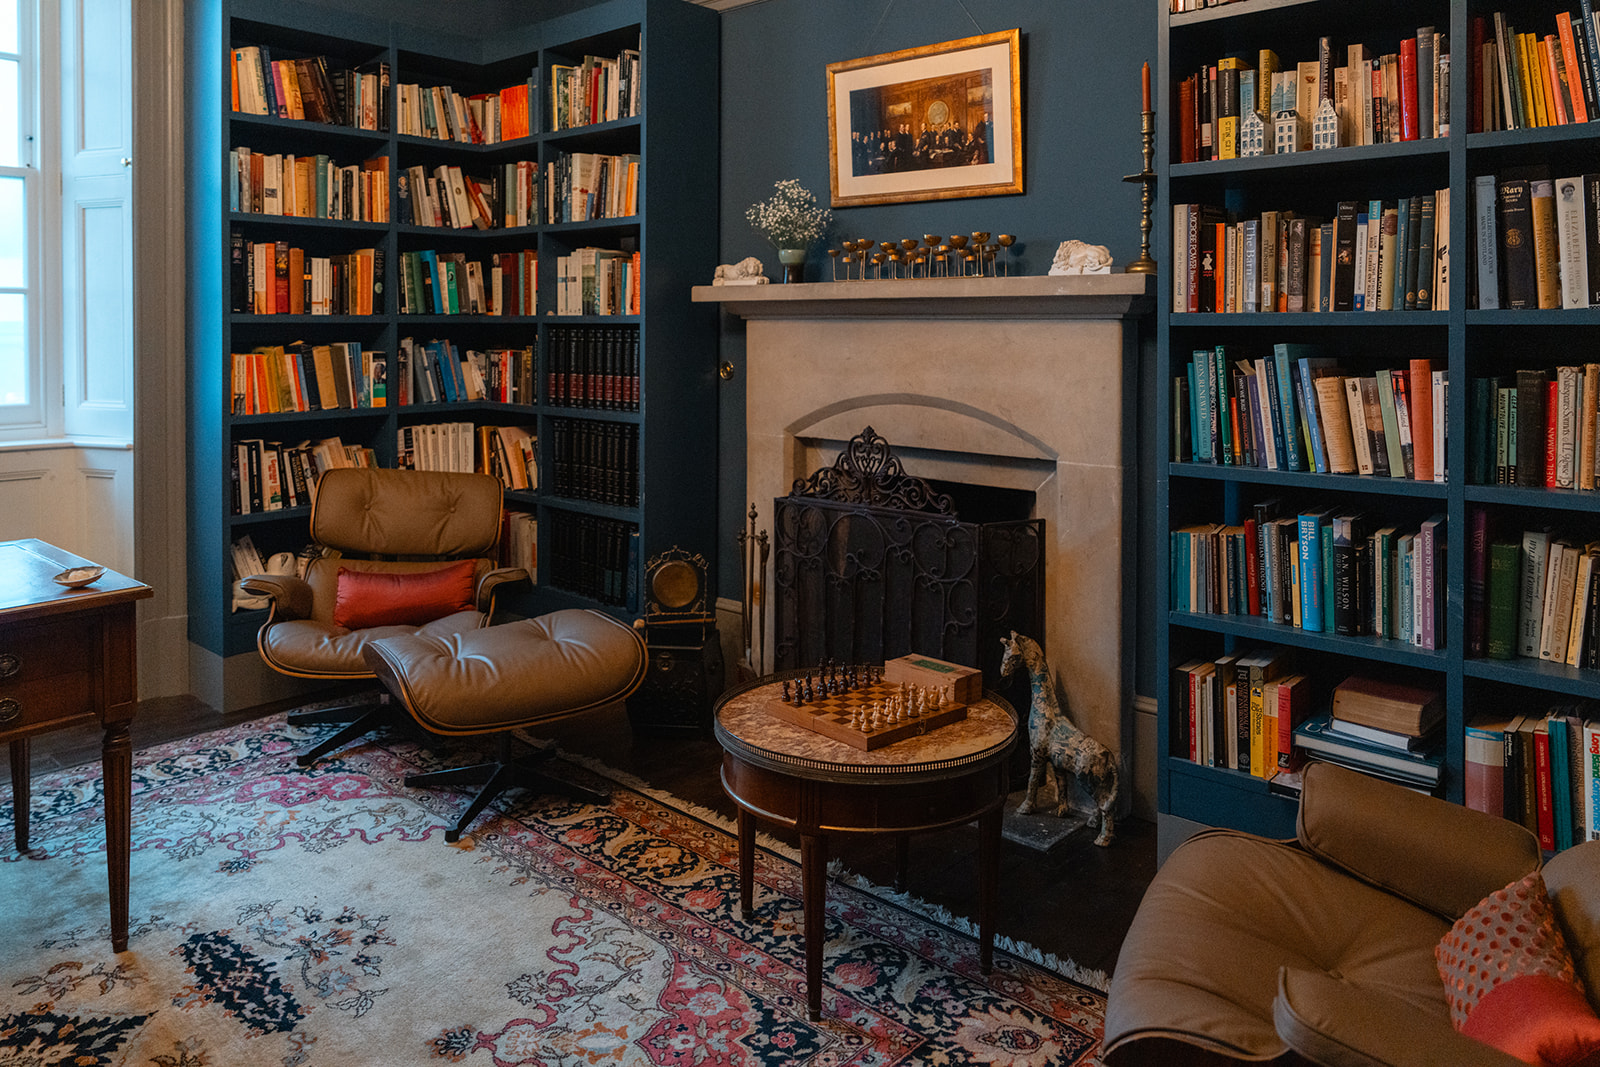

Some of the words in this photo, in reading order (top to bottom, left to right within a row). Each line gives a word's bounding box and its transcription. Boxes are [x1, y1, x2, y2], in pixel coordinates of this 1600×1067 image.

[1246, 224, 1255, 247] The
[1571, 210, 1579, 262] ELIZABETH
[1246, 249, 1255, 275] Barn
[1293, 243, 1301, 267] Robert
[1300, 521, 1309, 560] BRYSON
[1307, 521, 1315, 541] BILL
[1473, 529, 1483, 553] WOK
[1425, 556, 1431, 565] TO
[1527, 539, 1537, 575] WILLIAM
[1589, 732, 1600, 754] Long
[1592, 754, 1600, 779] Island
[1590, 778, 1600, 831] Compromise
